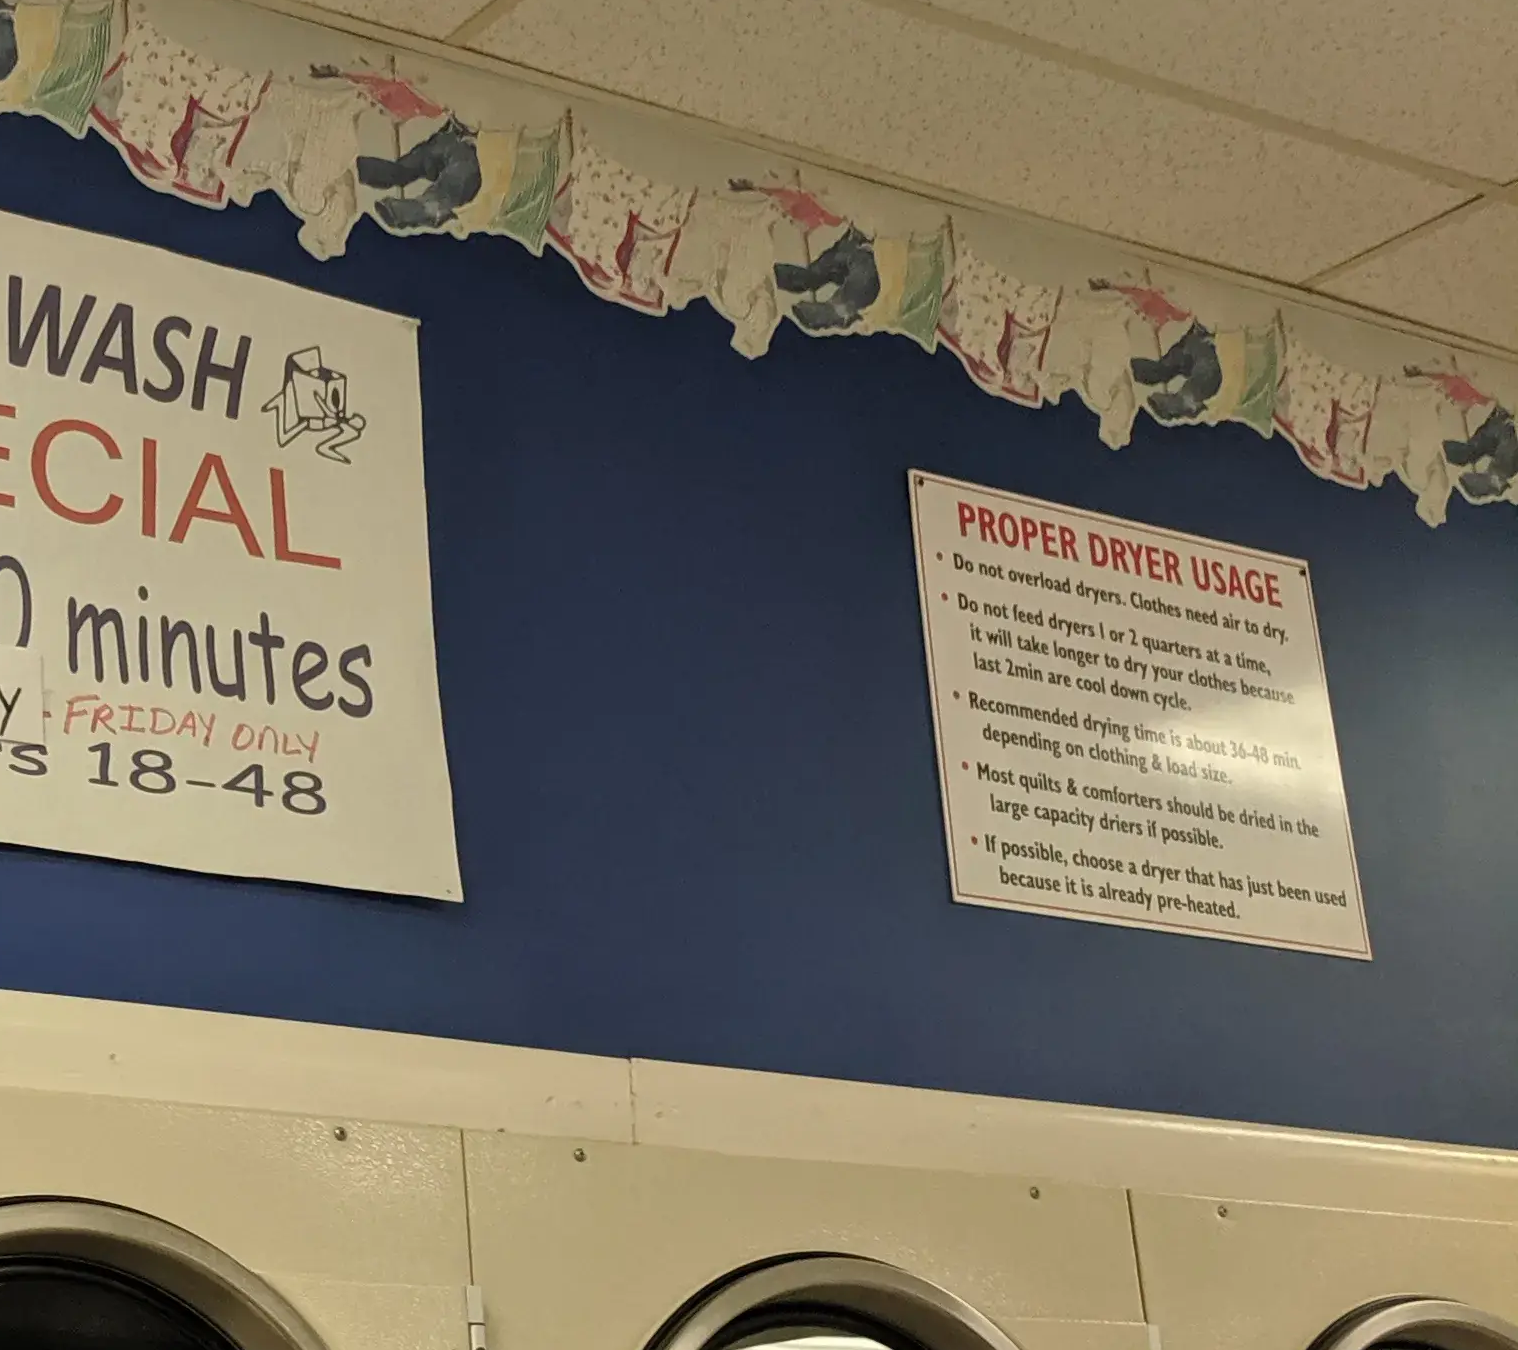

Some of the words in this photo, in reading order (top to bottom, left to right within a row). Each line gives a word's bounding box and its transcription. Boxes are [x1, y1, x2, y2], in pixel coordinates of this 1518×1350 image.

[7, 274, 252, 420] WASH
[957, 501, 1080, 563] PROPER
[1088, 532, 1183, 586] DRYER
[1190, 555, 1283, 608] USAGE
[953, 553, 974, 573] Do
[979, 562, 1005, 580] not
[1008, 568, 1071, 595] overload
[1076, 581, 1127, 606] dryers.
[1130, 592, 1182, 618] Clothes
[1185, 608, 1218, 627] need
[1222, 614, 1241, 631] air
[1244, 619, 1259, 635] to
[1263, 622, 1289, 645] dry.
[957, 593, 979, 613] Do
[983, 602, 1010, 620] not
[1012, 604, 1044, 627] feed
[1049, 613, 1095, 638] dryers
[1110, 629, 1125, 644] or
[1129, 629, 1138, 646] 2
[1142, 636, 1202, 660] quarters
[1206, 648, 1220, 664] at
[1224, 652, 1232, 666] a
[1236, 651, 1272, 677] time,
[67, 585, 373, 718] minutes
[970, 623, 982, 642] it
[986, 629, 1012, 649] will
[1017, 635, 1049, 655] take
[1053, 641, 1099, 668] longer
[1104, 653, 1119, 670] to
[1124, 655, 1147, 680] dry
[1151, 664, 1184, 683] your
[1188, 669, 1236, 694] clothes
[1240, 679, 1296, 705] because
[973, 651, 1002, 674] last
[1005, 658, 1043, 683] 2min
[1047, 671, 1072, 688] are
[1076, 676, 1106, 695] cool
[1110, 680, 1149, 702] down
[1153, 691, 1192, 711] cycle.
[63, 694, 216, 747] FRIDAY
[968, 691, 1078, 728] Recommended
[1083, 713, 1131, 743] drying
[1134, 723, 1166, 744] time
[1170, 729, 1182, 747] is
[1186, 734, 1227, 756] about
[982, 723, 1062, 758] depending
[1065, 742, 1084, 758] on
[1089, 743, 1147, 774] clothing
[1151, 753, 1162, 771] &
[1166, 756, 1198, 778] load
[88, 742, 328, 815] 18-48
[976, 761, 1015, 786] Most
[1019, 772, 1062, 794] quilts
[1066, 778, 1078, 796] &
[1082, 784, 1163, 812] comforters
[1167, 796, 1214, 820] should
[1217, 804, 1235, 824] be
[1239, 808, 1276, 831] dried
[1279, 815, 1293, 833] in
[1296, 818, 1320, 838] the
[990, 793, 1029, 821] large
[1034, 804, 1094, 833] capacity
[1099, 812, 1143, 836] driers
[1147, 819, 1157, 838] if
[1161, 826, 1224, 849] possible.
[984, 833, 997, 853] If
[1001, 839, 1068, 867] possible,
[1072, 848, 1124, 873] choose
[1128, 861, 1137, 875] a
[1141, 859, 1181, 884] dryer
[1185, 866, 1215, 887] that
[1219, 871, 1243, 891] has
[1247, 875, 1274, 898] just
[1277, 879, 1311, 901] been
[1315, 890, 1347, 907] used
[999, 865, 1061, 892] because
[1065, 875, 1078, 896] it
[1082, 878, 1094, 897] is
[1098, 882, 1153, 911] already
[1157, 893, 1241, 919] pre-heated.
